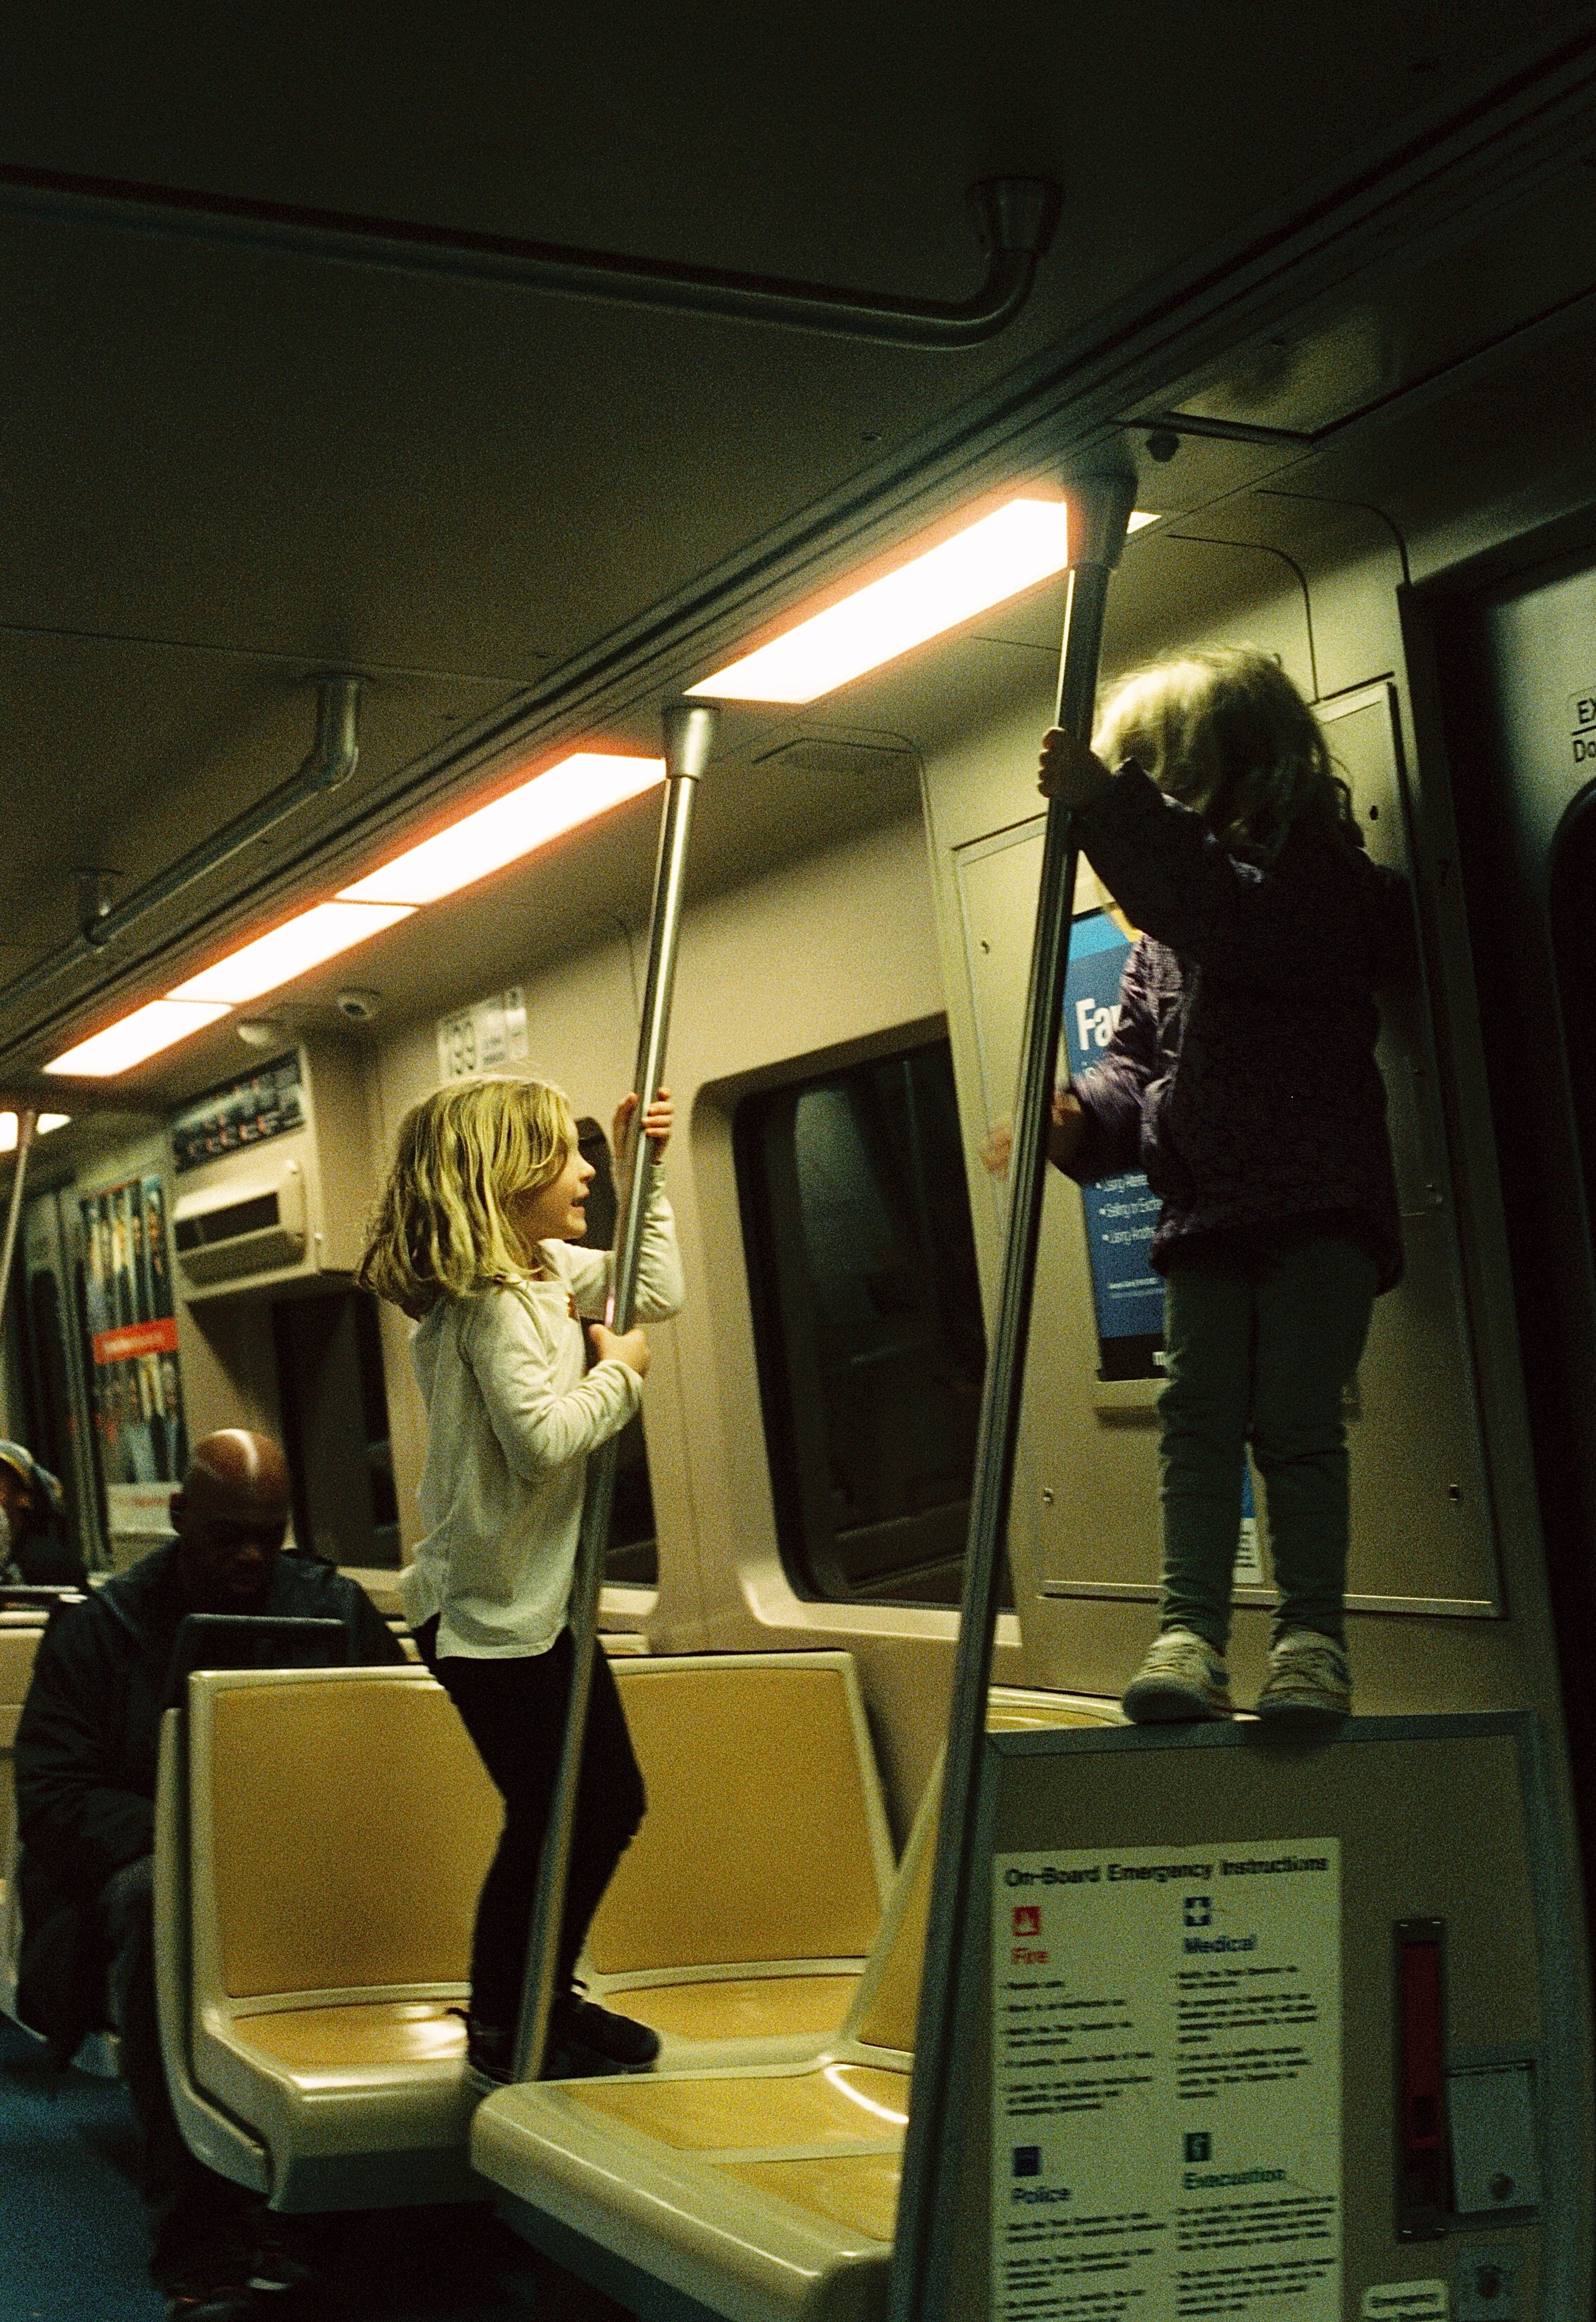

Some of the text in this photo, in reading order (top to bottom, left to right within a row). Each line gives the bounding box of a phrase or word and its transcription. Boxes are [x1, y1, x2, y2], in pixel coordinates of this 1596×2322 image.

[1004, 1857, 1329, 1887] On-Board Emergency Instructions
[1183, 1935, 1257, 1953] Medical
[1011, 1947, 1048, 1965] Fire
[1183, 2168, 1286, 2189] Evacuation
[1012, 2186, 1071, 2204] Police
